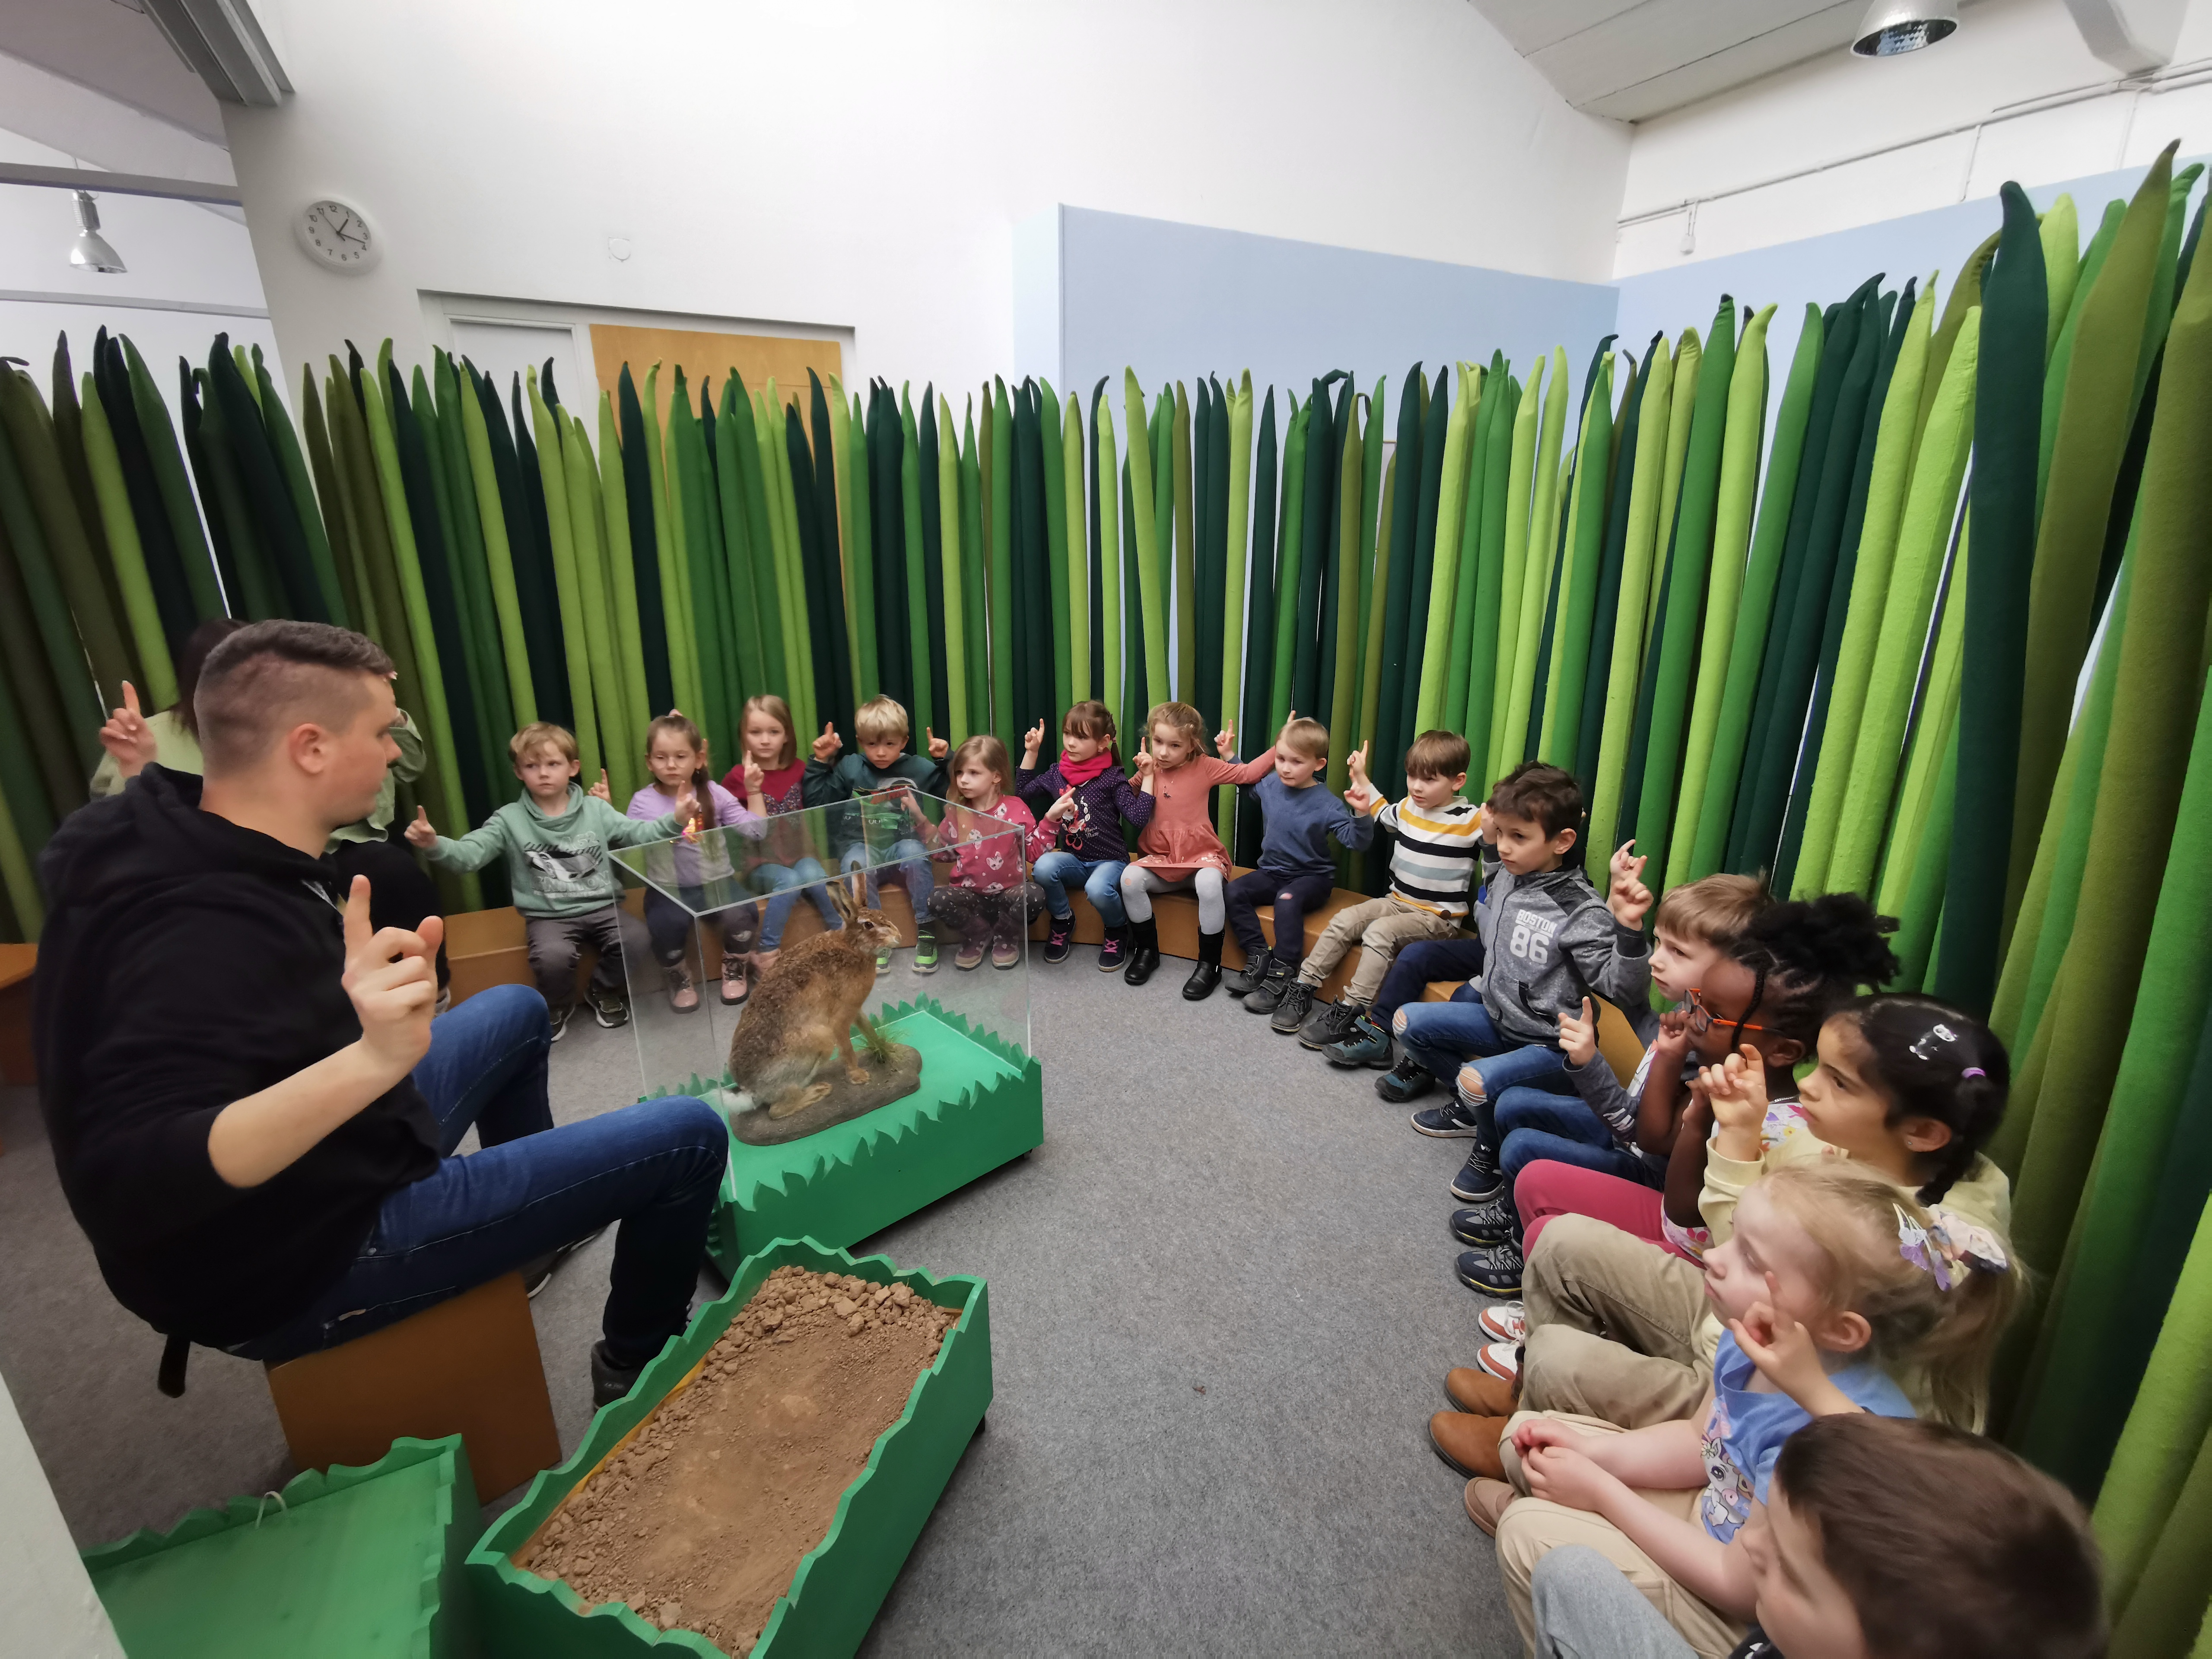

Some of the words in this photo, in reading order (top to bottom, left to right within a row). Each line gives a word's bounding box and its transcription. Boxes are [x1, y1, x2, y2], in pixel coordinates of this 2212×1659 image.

[363, 232, 368, 240] 3
[1516, 909, 1558, 934] BOSTON
[1510, 925, 1549, 963] 86
